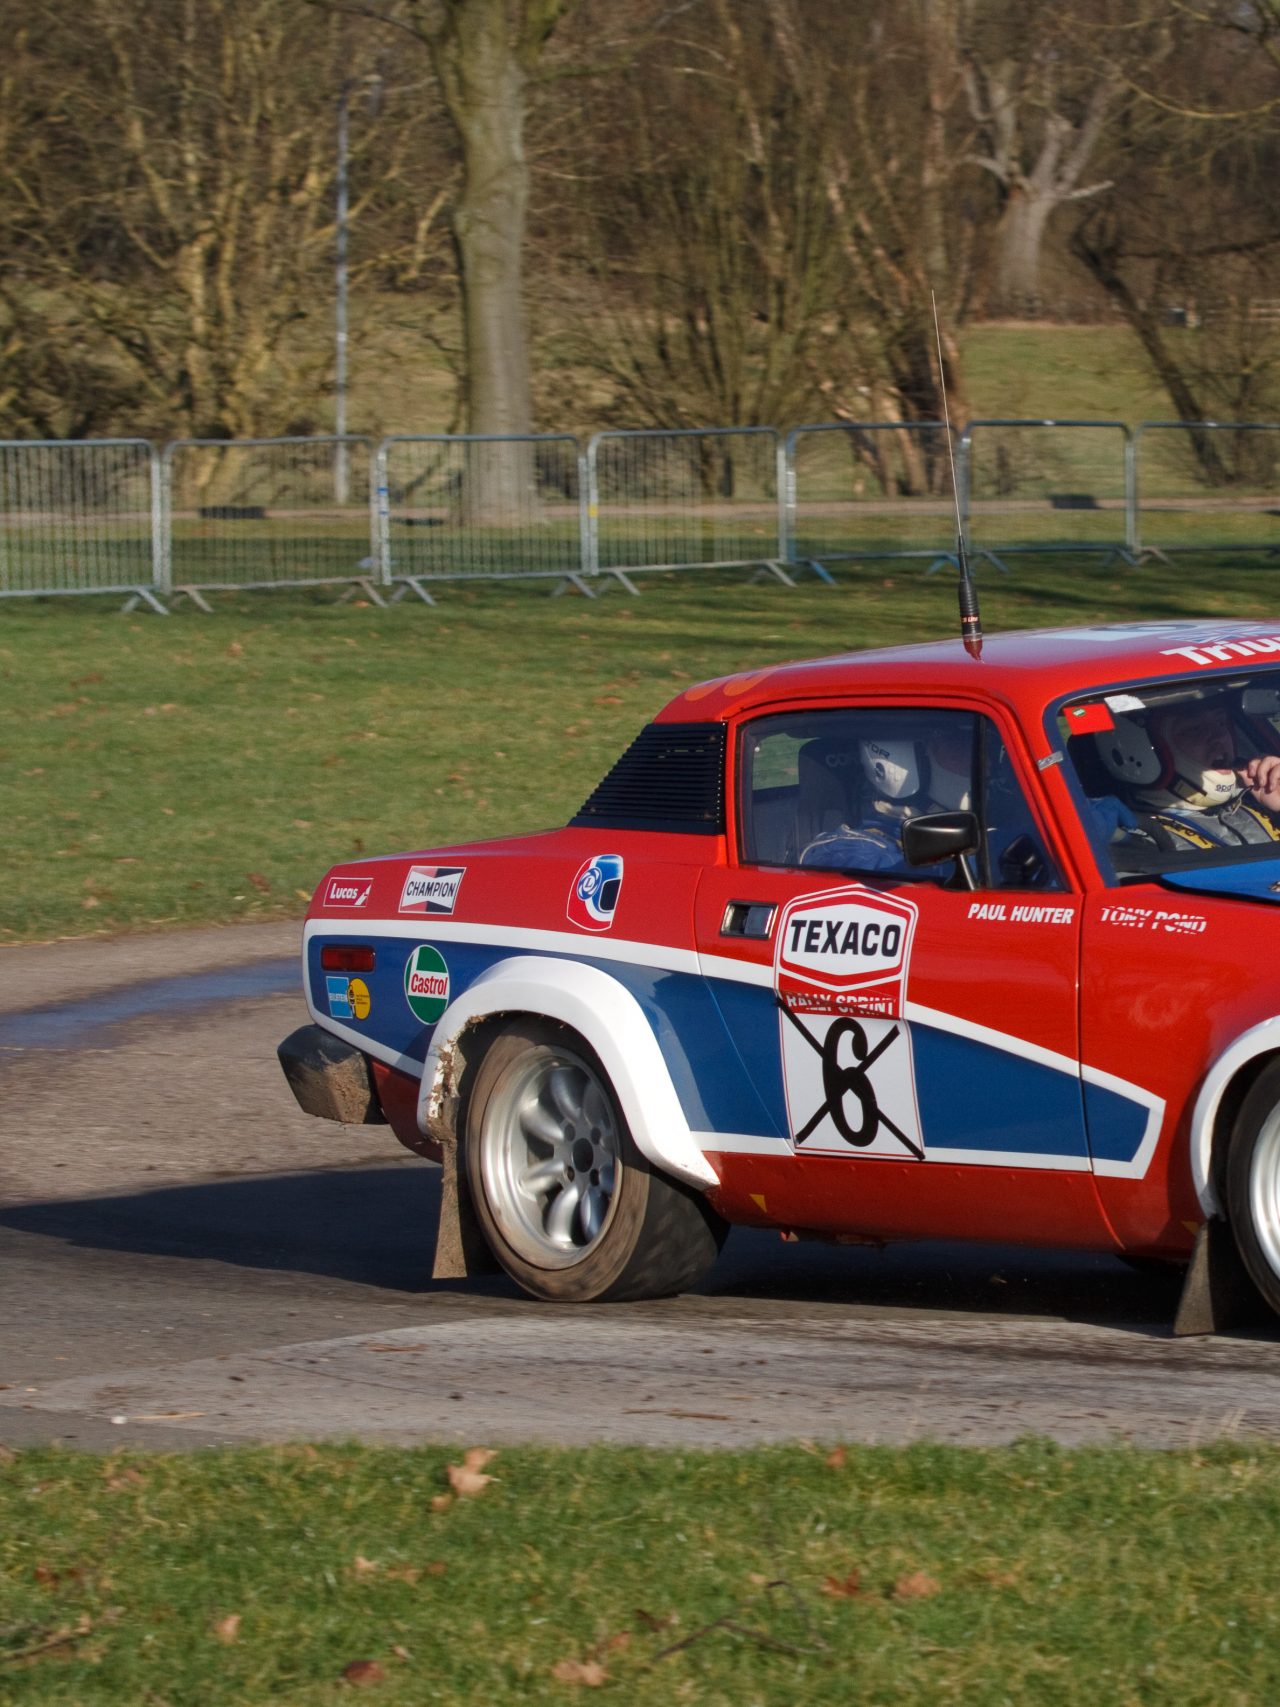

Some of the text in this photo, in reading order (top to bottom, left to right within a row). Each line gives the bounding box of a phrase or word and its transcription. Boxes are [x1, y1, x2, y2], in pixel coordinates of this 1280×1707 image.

[330, 883, 358, 900] Lucas
[406, 881, 456, 897] CHAMPION
[967, 903, 1075, 925] PAUL HUNTER
[1101, 905, 1154, 928] TONY
[790, 919, 901, 958] TEXACO
[411, 973, 448, 995] Castrol
[822, 1016, 879, 1148] 6
